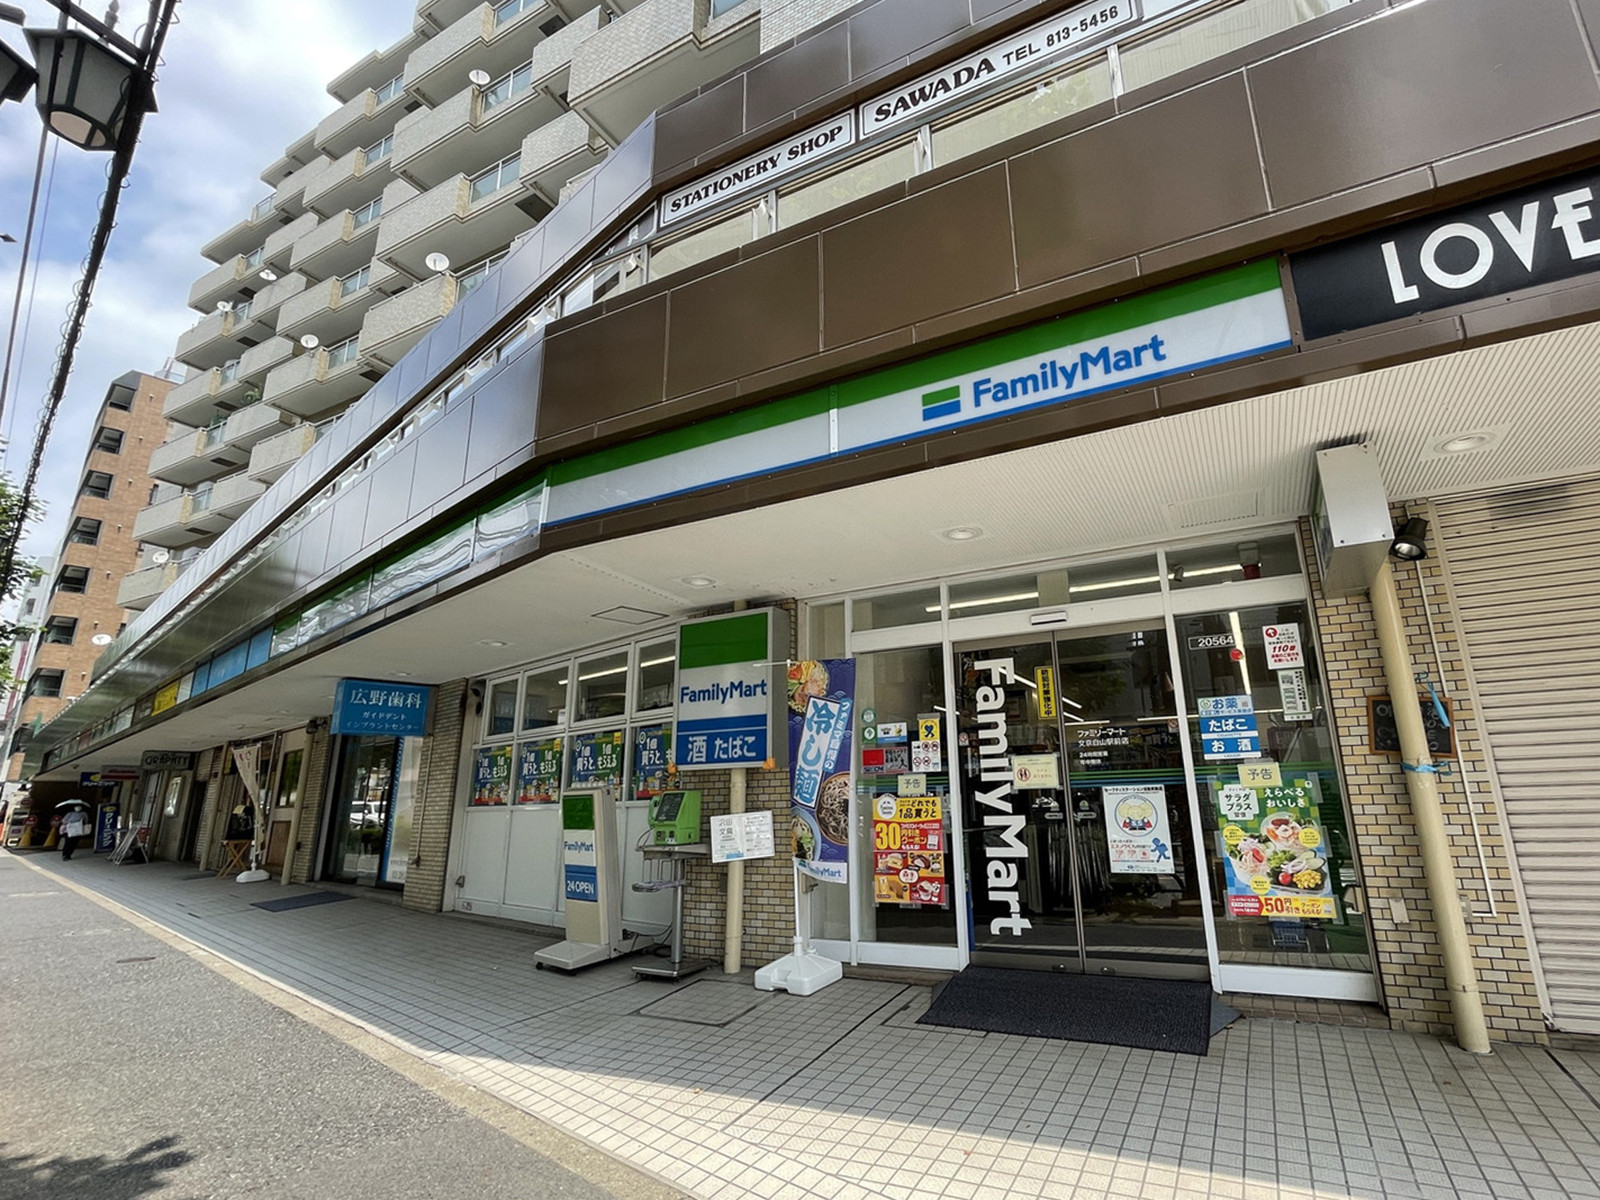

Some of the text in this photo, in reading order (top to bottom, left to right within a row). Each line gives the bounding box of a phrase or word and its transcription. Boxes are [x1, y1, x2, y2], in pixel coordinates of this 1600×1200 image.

[874, 5, 1118, 123] SAWADA TEL 813-5456
[670, 125, 843, 213] STATIONERY SHOP
[973, 334, 1167, 408] FamilyMart
[1197, 634, 1235, 648] 20564
[349, 688, 423, 709] 広野歯科
[680, 679, 768, 704] FamilyMart
[1211, 698, 1239, 709] お薬
[1208, 718, 1249, 732] たばこ
[1077, 727, 1126, 738] ファミリーマート
[687, 735, 757, 763] 酒 たばこ
[1247, 768, 1273, 781] 予告
[903, 778, 921, 789] 予告
[973, 656, 1033, 937] FamilyMart
[1224, 792, 1252, 803] サラダ
[1264, 787, 1305, 798] えらべる
[911, 799, 937, 808] どれでも
[1226, 802, 1253, 812] プラス
[1266, 798, 1306, 808] おいしさ
[898, 808, 938, 819] 1品買うと
[875, 823, 901, 850] 30
[564, 840, 594, 854] FamilyMart
[1264, 897, 1285, 914] 50
